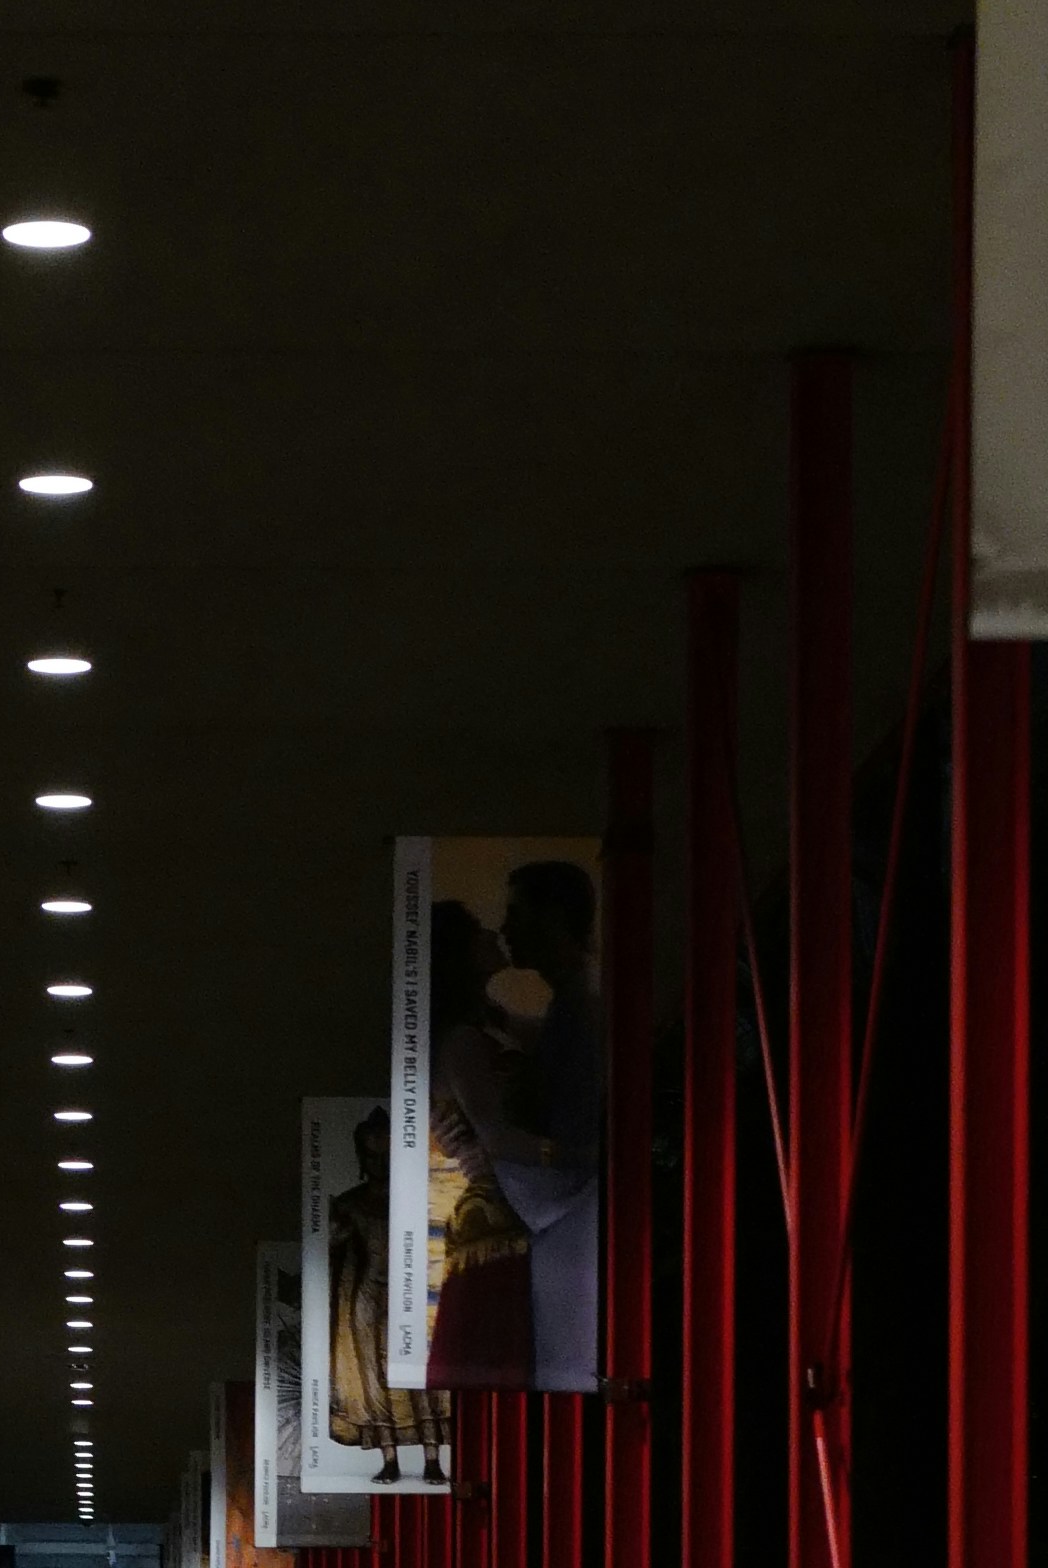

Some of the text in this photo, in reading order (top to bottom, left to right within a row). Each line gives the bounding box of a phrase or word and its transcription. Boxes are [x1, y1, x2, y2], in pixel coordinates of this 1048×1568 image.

[405, 870, 420, 926] YOUSSEF
[405, 930, 419, 977] NABIL'S
[404, 989, 418, 1030] SAVED
[404, 1034, 417, 1053] MY
[403, 1057, 417, 1094] BELLY
[402, 1098, 416, 1149] DANCER
[402, 1272, 413, 1312] PAVILION
[399, 1324, 413, 1357] LACMA
